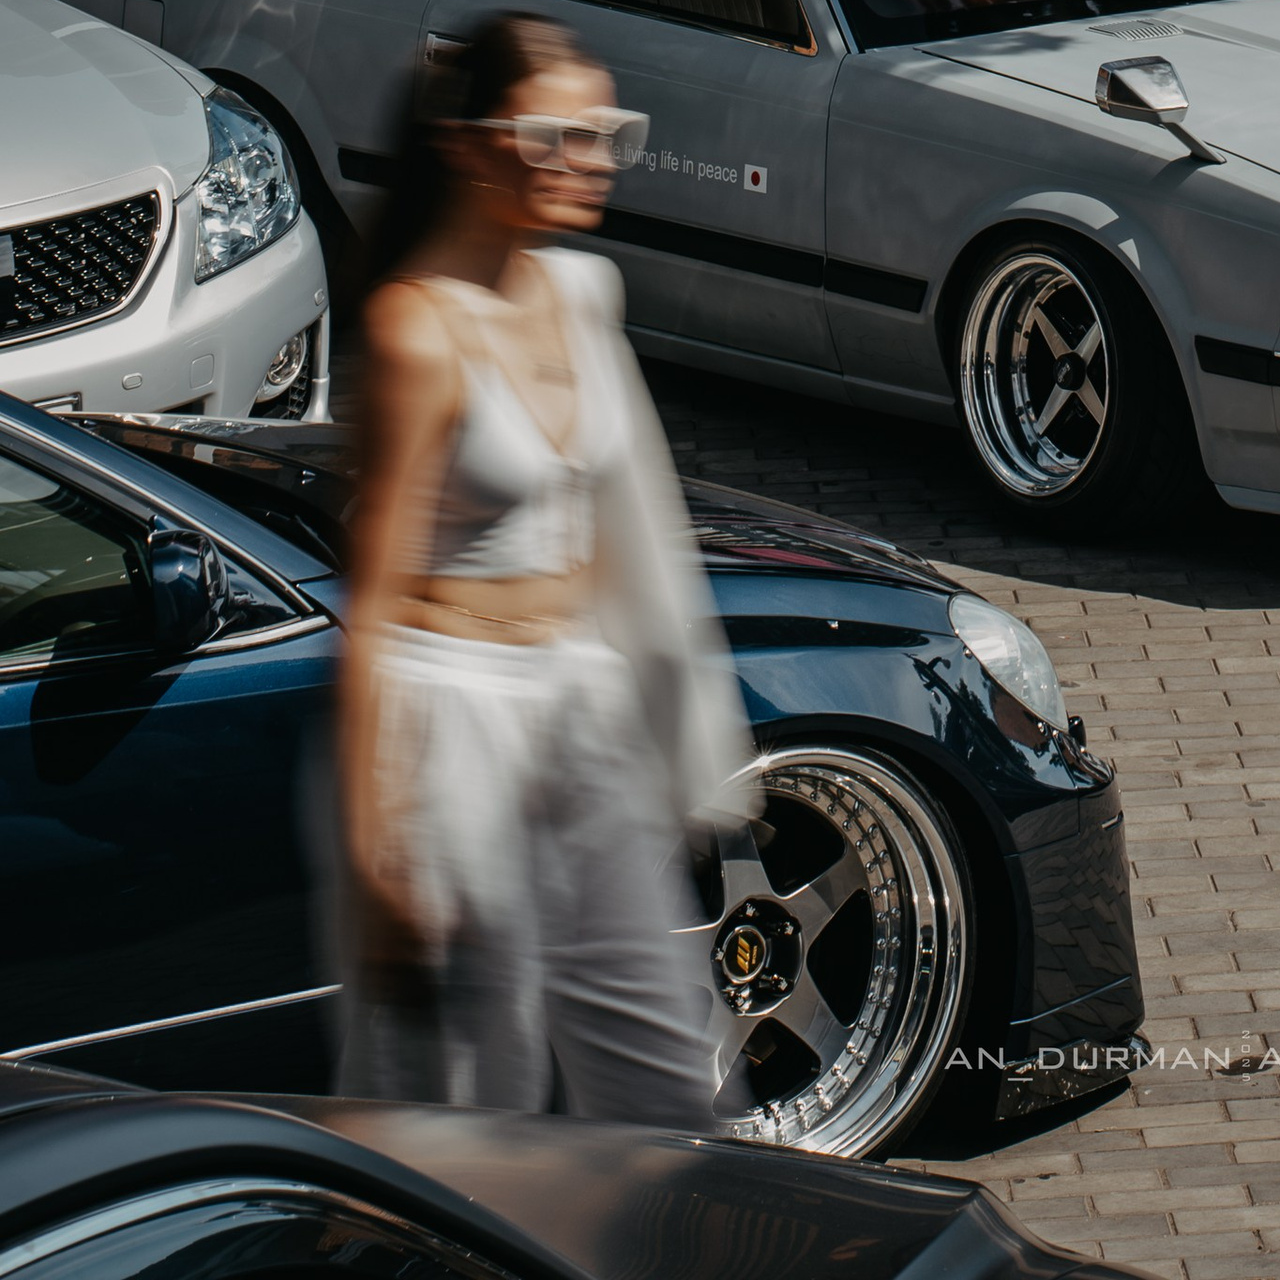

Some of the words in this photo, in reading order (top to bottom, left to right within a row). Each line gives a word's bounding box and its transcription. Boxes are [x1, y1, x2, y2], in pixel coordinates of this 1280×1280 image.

[624, 143, 657, 172] living
[660, 149, 679, 172] life
[682, 155, 694, 175] in
[697, 162, 738, 184] peace
